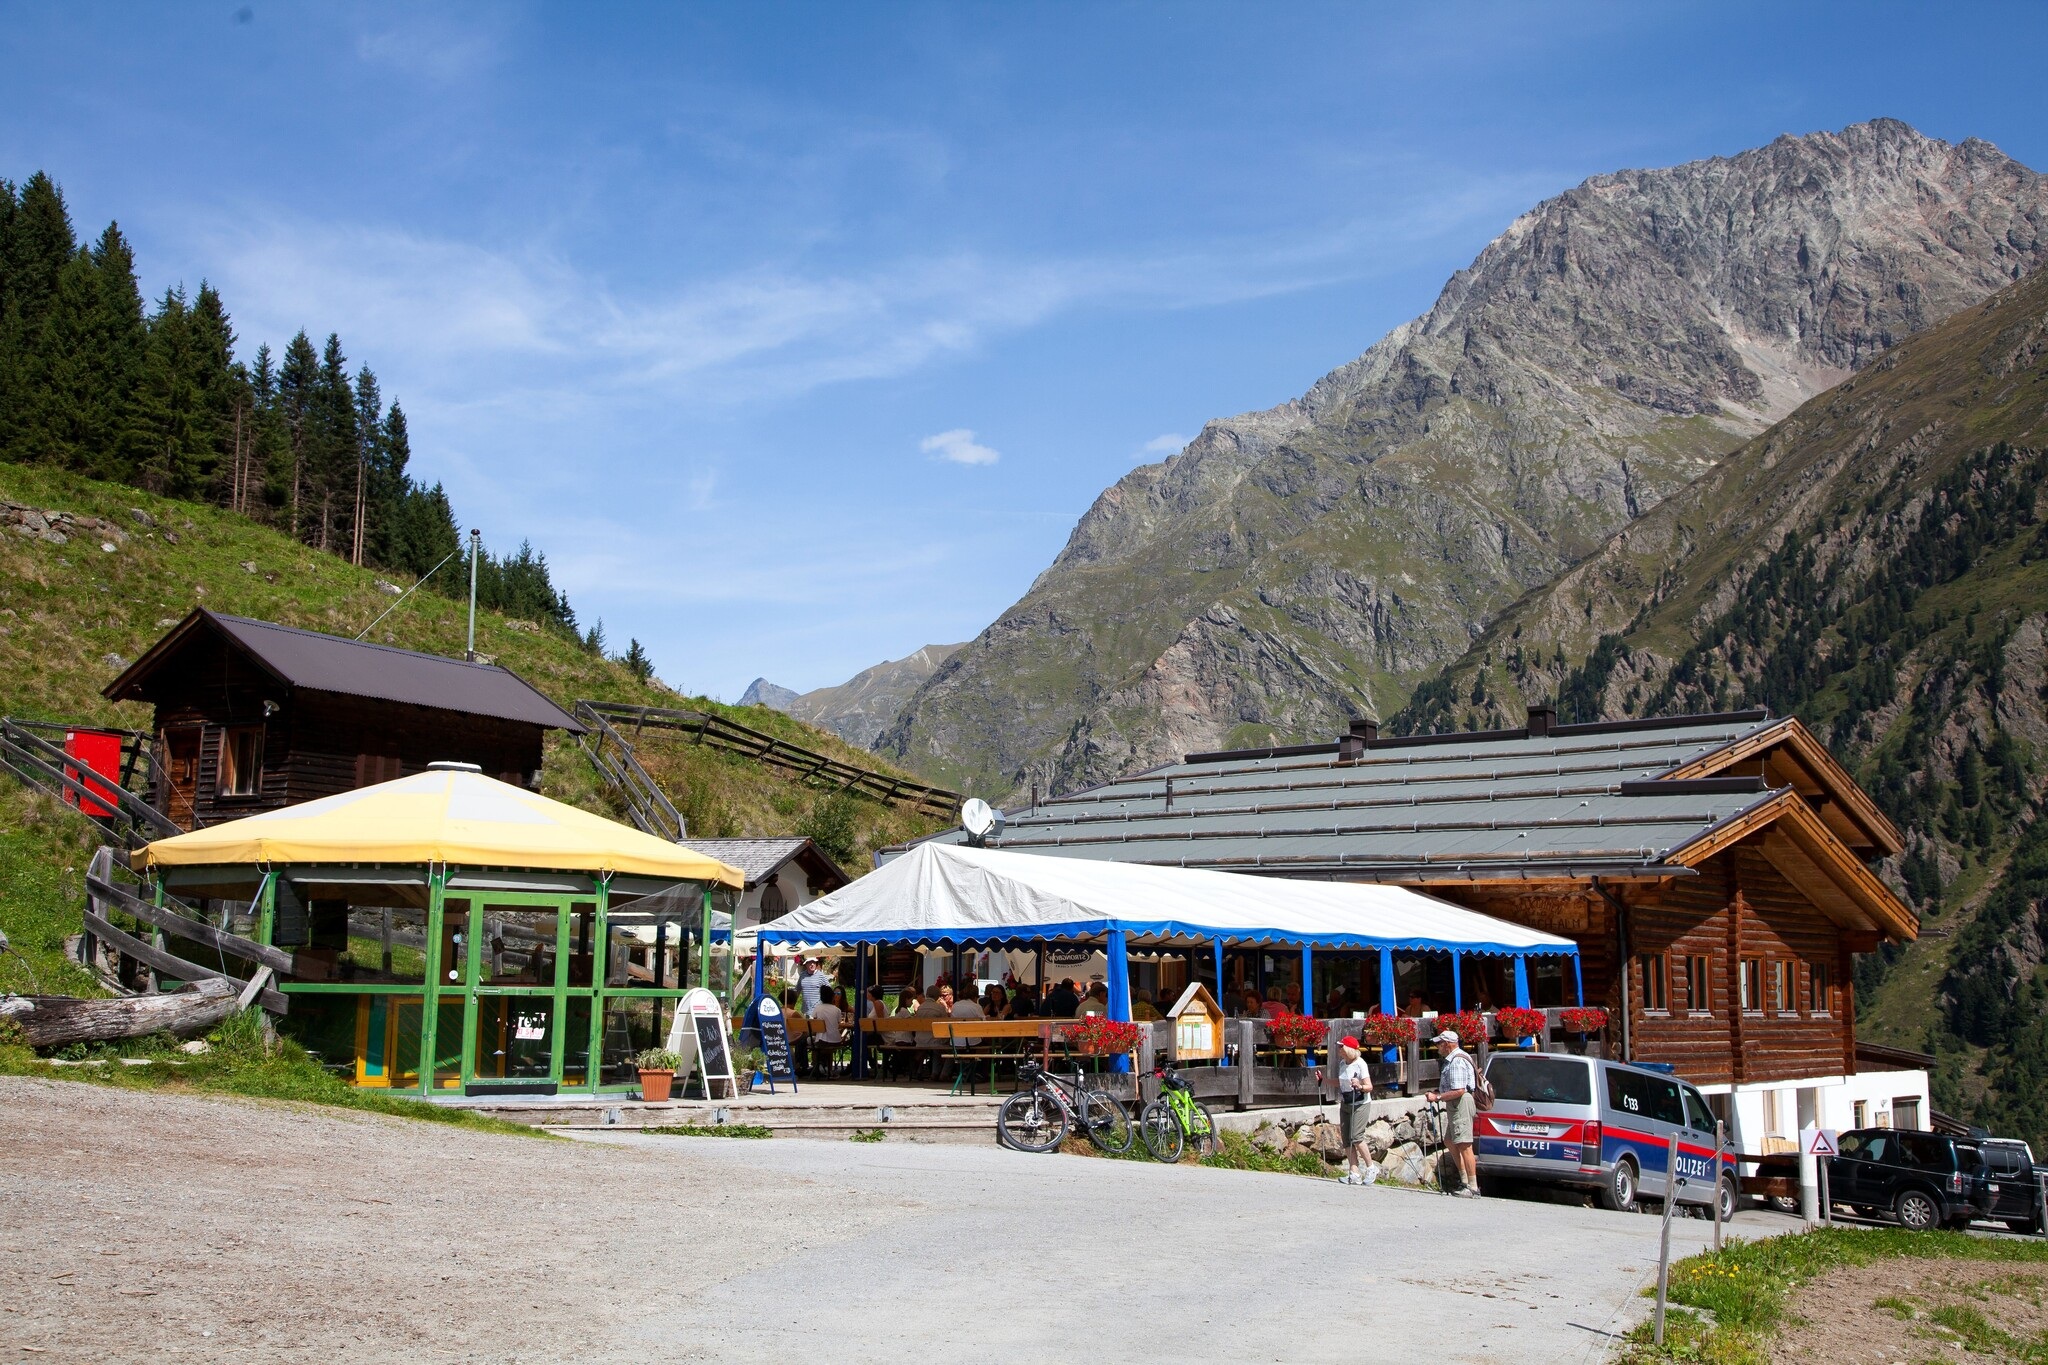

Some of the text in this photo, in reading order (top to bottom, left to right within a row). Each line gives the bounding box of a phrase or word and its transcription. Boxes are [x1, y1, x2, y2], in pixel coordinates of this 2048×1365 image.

[1628, 1098, 1639, 1112] 133
[1506, 1139, 1550, 1151] POLIZEI
[1675, 1156, 1706, 1177] OLIZEI
